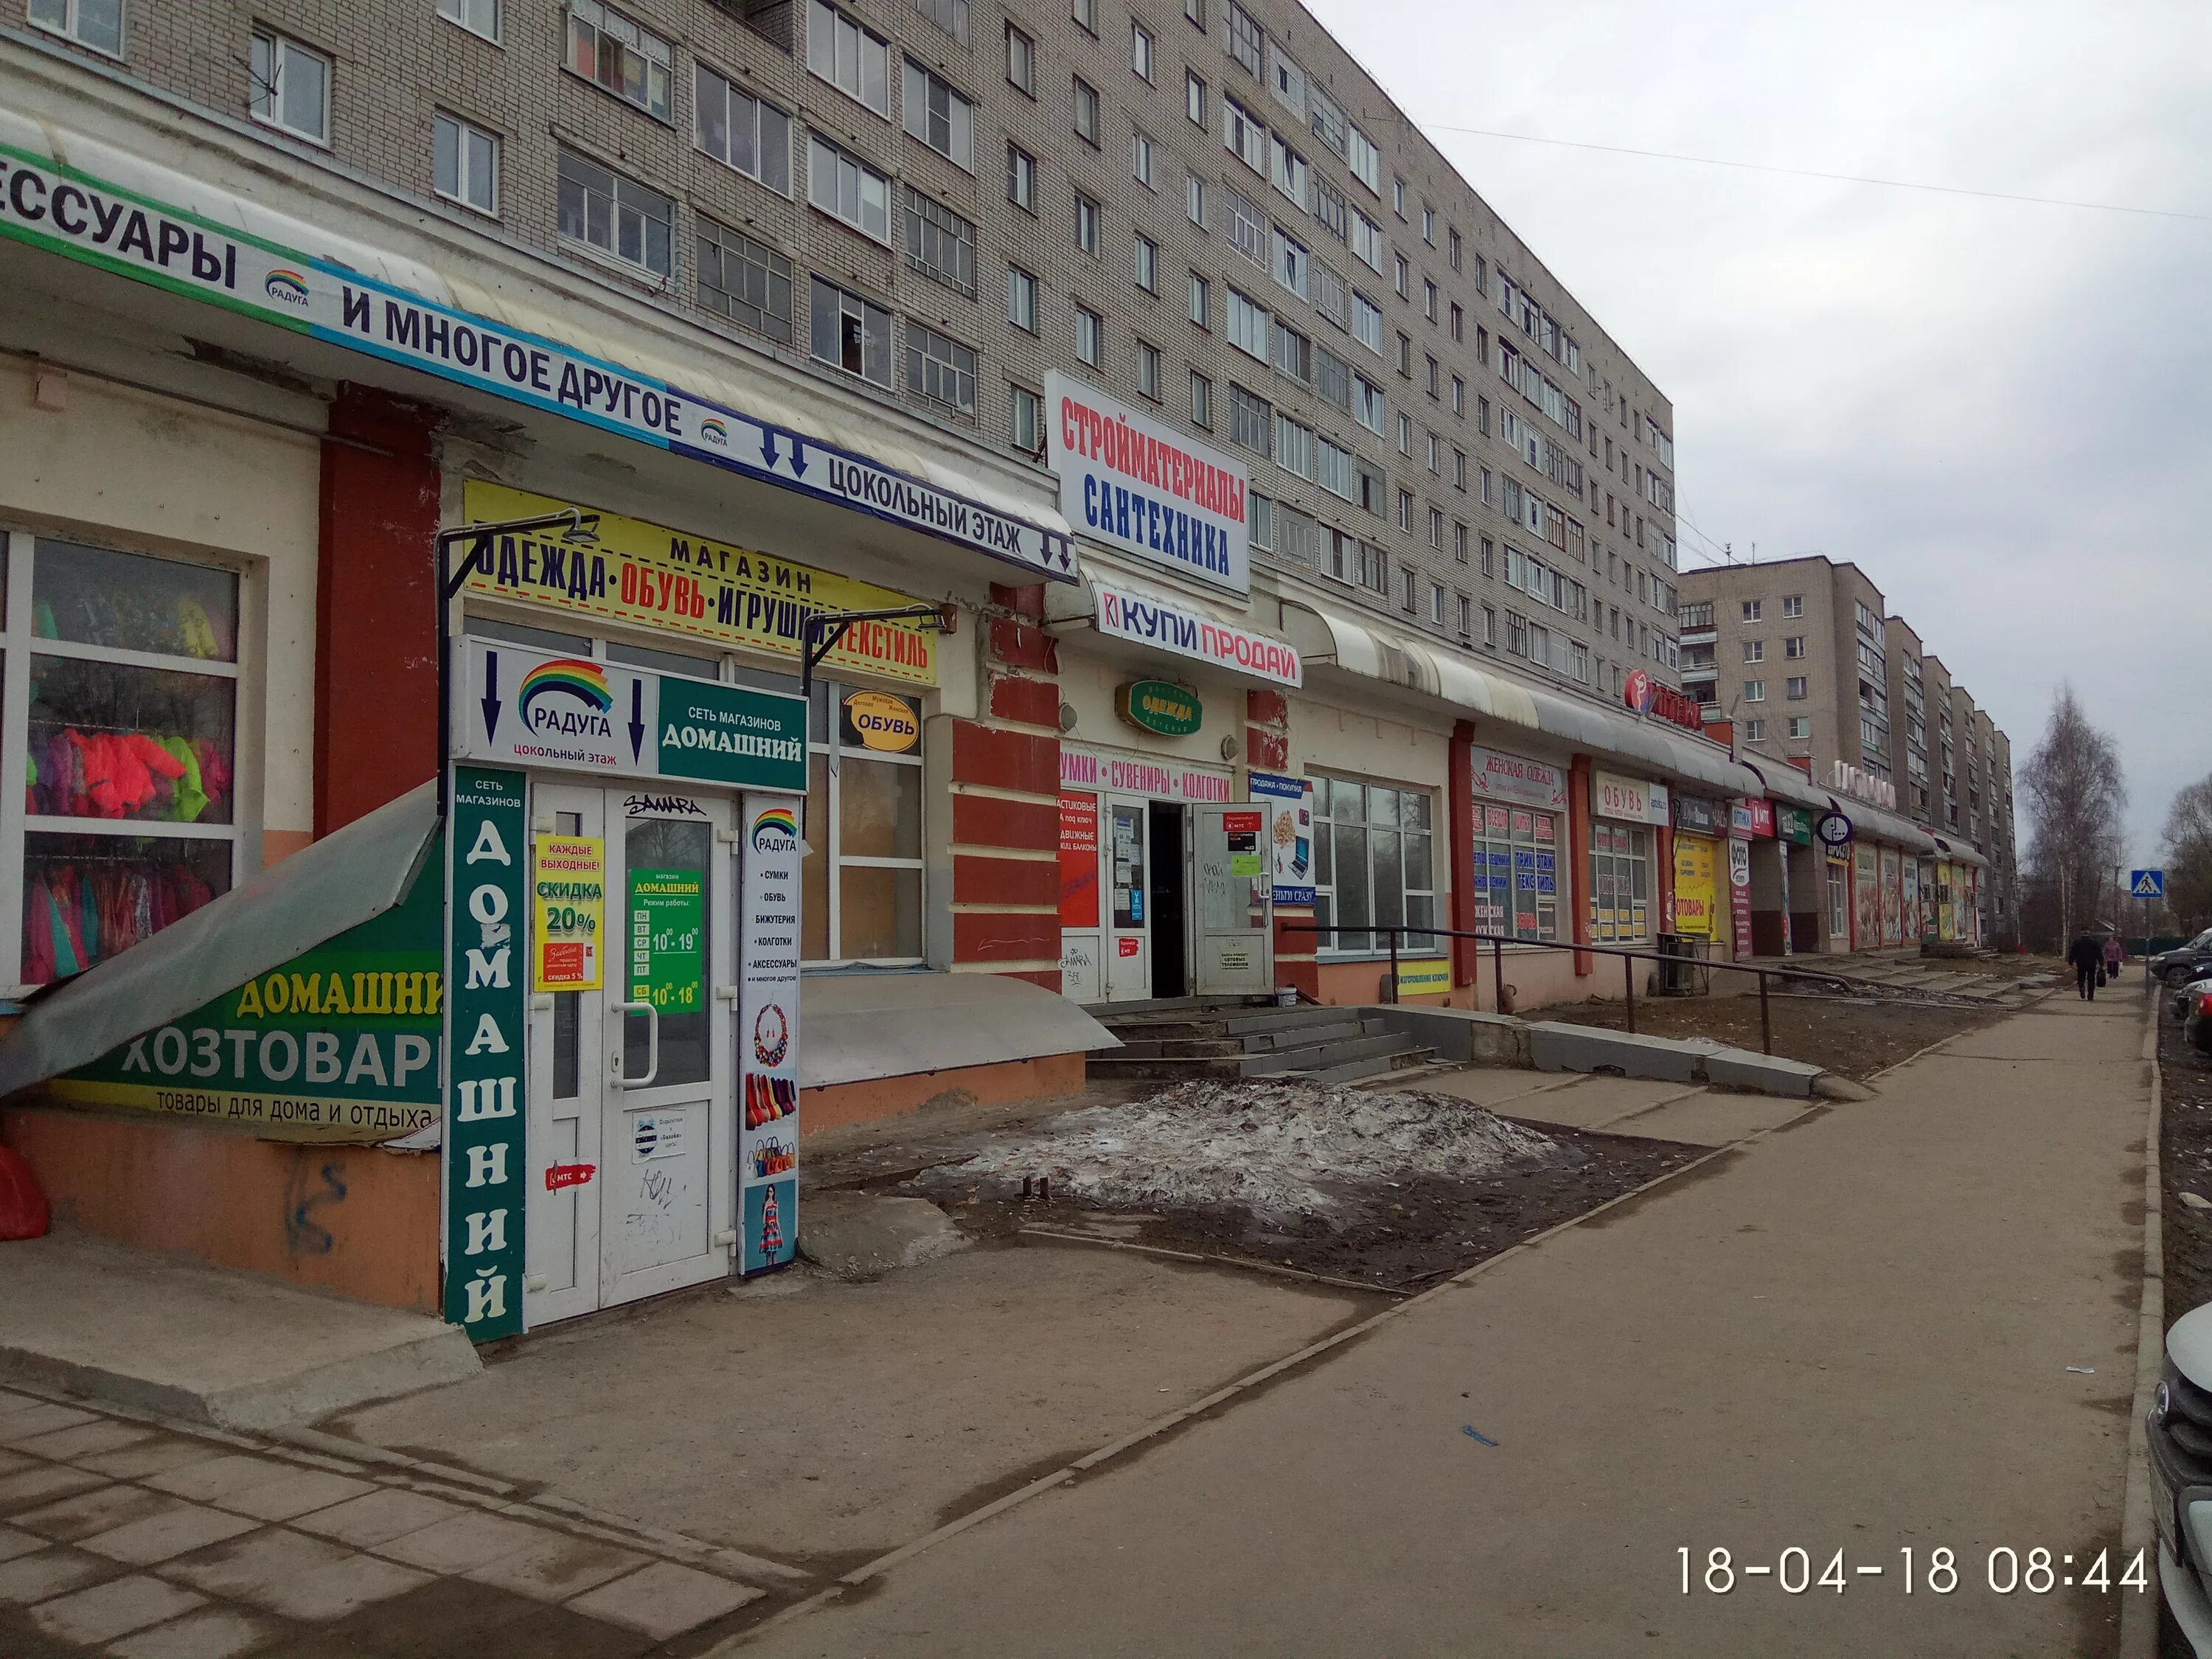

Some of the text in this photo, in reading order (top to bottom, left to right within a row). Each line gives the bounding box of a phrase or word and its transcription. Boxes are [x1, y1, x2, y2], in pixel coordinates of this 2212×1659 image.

[0, 161, 236, 290] ССУАРЫ
[271, 286, 309, 307] РАДУГА
[342, 286, 681, 437] И МНОГОЕ ДРУГОЕ
[704, 431, 728, 447] РАДУГА
[1061, 396, 1245, 524] СТРОЙМАТЕРИАЛЫ
[829, 458, 1021, 554] ЦОКОЛЬНЫЙ ЭТАЖ
[1084, 473, 1229, 577] САНТЕХНИКА
[670, 538, 810, 594] МАГАЗИН
[476, 534, 605, 602] ОДЕЖДА
[622, 563, 705, 619] ОБУВЬ
[838, 619, 928, 669] ТЕКСТИЛЬ
[1121, 597, 1296, 680] КУПИ ПРОДАЙ
[689, 706, 782, 731] СЕТЬ МАГАЗИНОВ
[1142, 695, 1192, 721] ОДЕЖДА
[535, 708, 611, 737] РАДУГА
[858, 714, 915, 735] ОБУВЬ
[661, 723, 802, 762] ДОМАШНИЙ
[513, 743, 617, 765] цокольный этаж
[1061, 752, 1229, 802] УМКИ СУВЕНИРЫ КОЛГОТКИ
[1486, 755, 1554, 786] ЖЕНСКАЯ ОДЕЖДА
[476, 780, 503, 791] СЕТЬ
[1251, 778, 1302, 793] ПРОДАЖА ПОКУПКА
[456, 794, 521, 807] МАГАЗИНОВ
[1604, 785, 1641, 812] ОБУВЬ
[549, 844, 592, 855] КАЖДЫЕ
[759, 838, 796, 852] РАДУГА
[1731, 842, 1747, 869] ФОТО
[540, 858, 600, 871] ВЫХОДНЫЕ!
[765, 871, 788, 880] СУМКИ
[537, 881, 602, 900] СКИДКА
[635, 882, 699, 894] ДОМАШНИЙ
[764, 892, 785, 902] ОБУВЬ
[1294, 891, 1313, 902] СРАЗУ
[546, 907, 596, 933] 20%
[756, 914, 796, 924] БИЖУТЕРИЯ
[637, 939, 647, 947] СР
[653, 933, 667, 951] 10
[679, 933, 693, 950] 19
[758, 937, 792, 946] КОЛГОТКИ
[753, 959, 797, 968] АКСЕССУАРЫ
[653, 988, 667, 1005] 10
[679, 987, 692, 1004] 18
[457, 819, 517, 1324] ДОМАШНИЙ
[156, 1091, 432, 1130] товары для дома и отдыха
[557, 1172, 572, 1181] МТС
